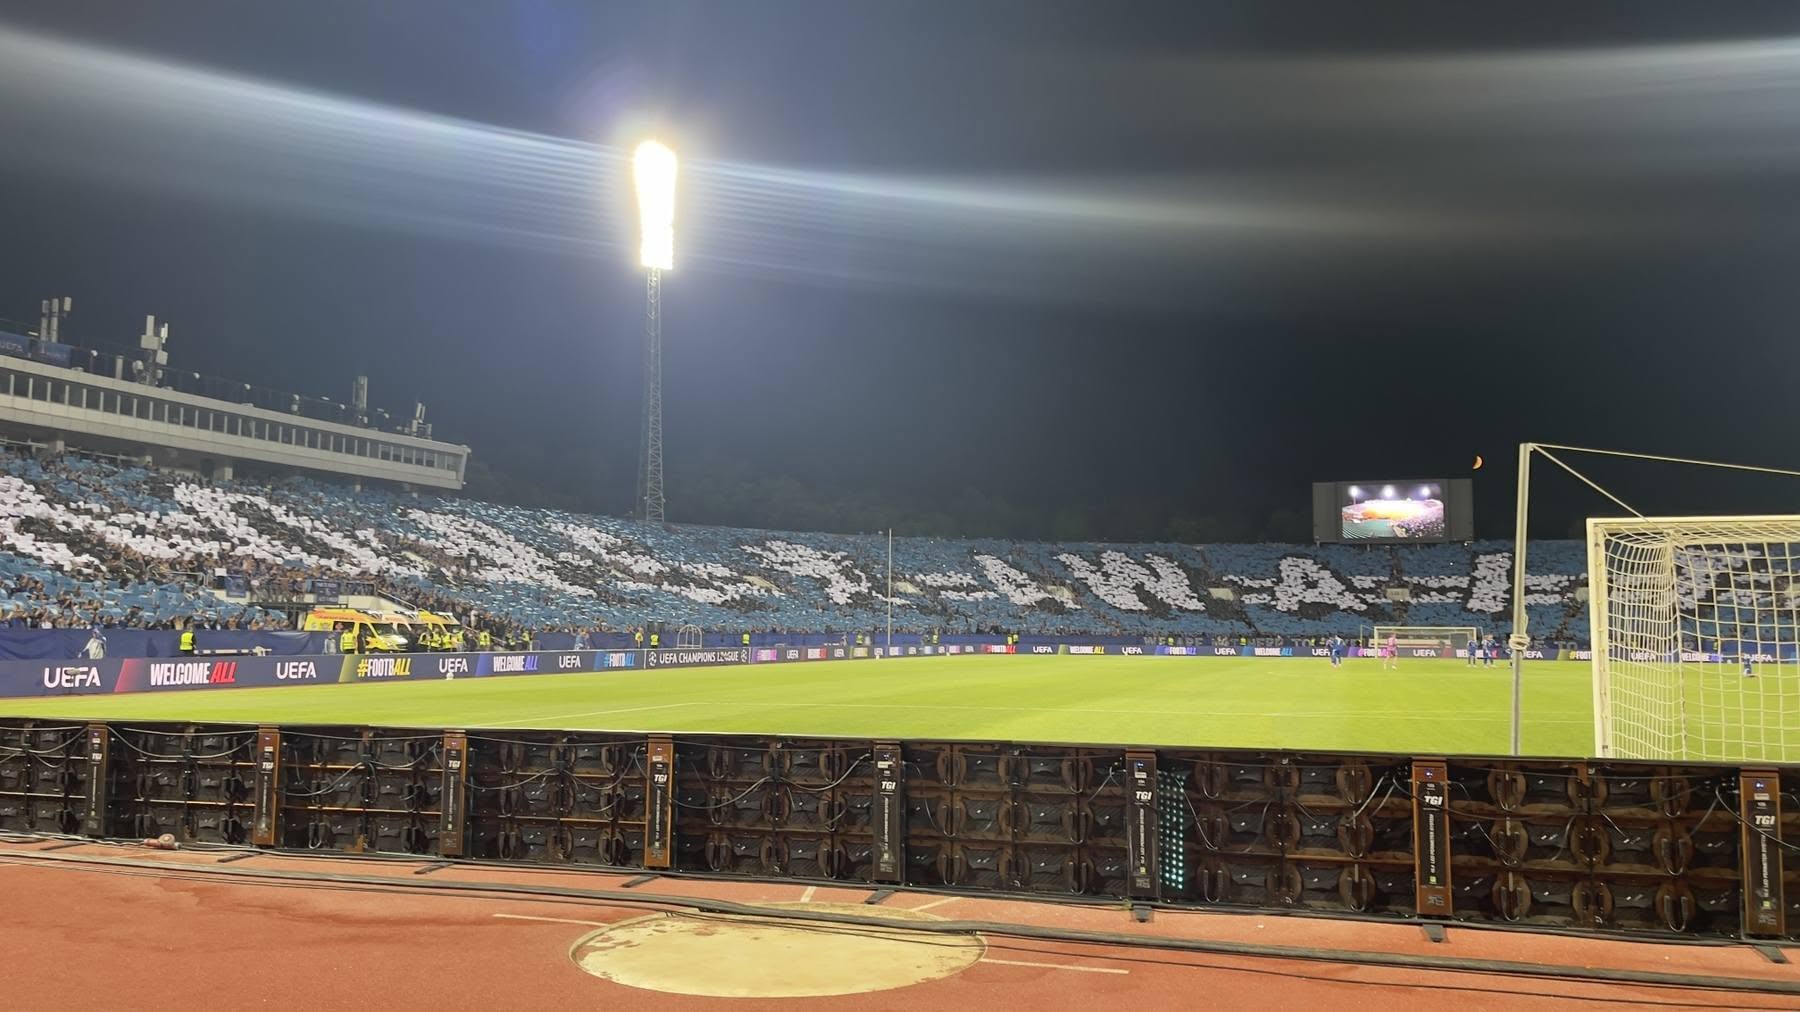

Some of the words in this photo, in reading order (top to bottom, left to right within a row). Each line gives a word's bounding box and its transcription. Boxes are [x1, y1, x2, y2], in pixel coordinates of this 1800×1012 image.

[1122, 646, 1142, 654] UEFA
[1214, 647, 1236, 655] UEFA
[1413, 649, 1436, 657] UEFA
[493, 655, 525, 672] WELCOME
[524, 655, 538, 671] ALL
[558, 655, 581, 669] UEFA
[660, 653, 678, 665] UEFA
[679, 651, 715, 664] CHAMPIONS
[276, 662, 317, 679] UEFA
[357, 658, 411, 678] #FOOTBALL
[438, 657, 468, 673] UEFA
[44, 667, 101, 688] UEFA
[150, 663, 210, 686] WELCOME
[209, 661, 237, 683] ALL
[448, 760, 461, 768] TGI
[654, 774, 668, 782] TGI
[881, 781, 896, 790] TGI
[1135, 791, 1152, 800] TGI
[1424, 795, 1443, 806] TGI
[1755, 815, 1776, 826] TGI
